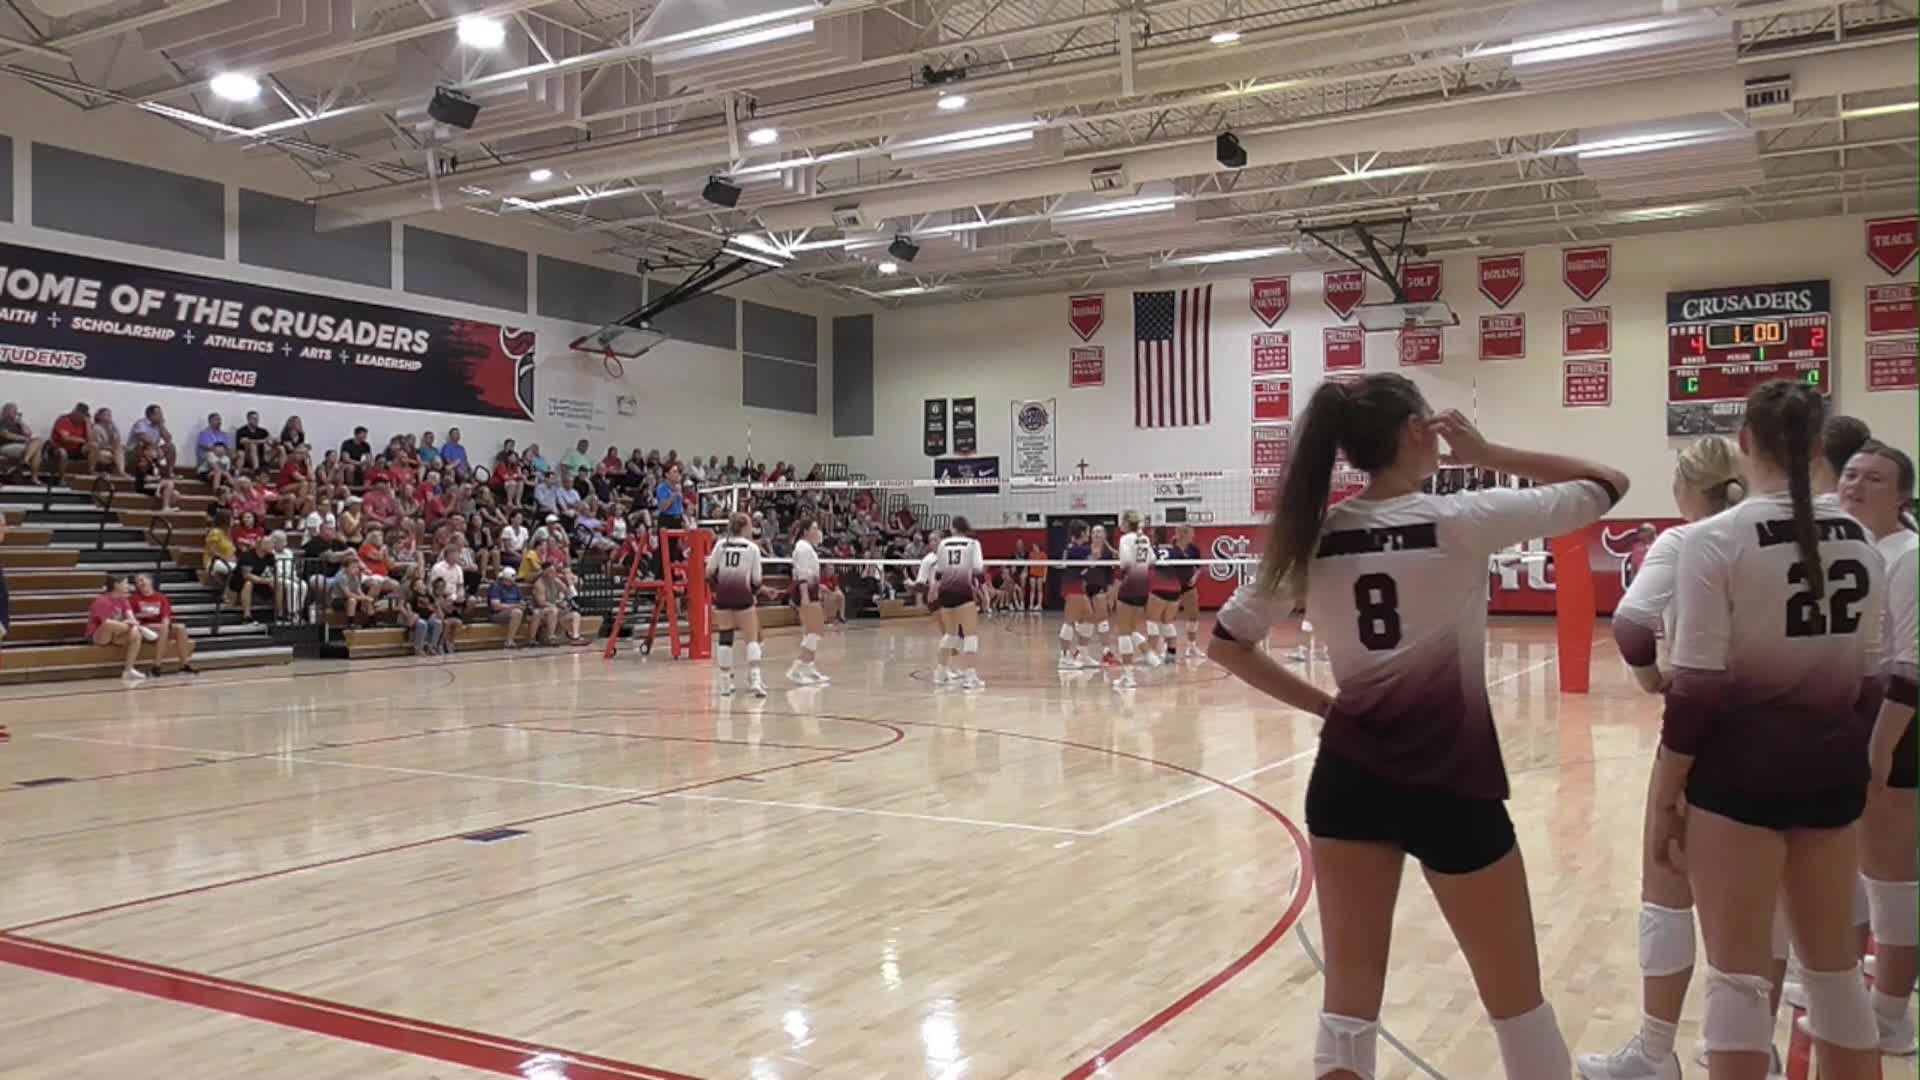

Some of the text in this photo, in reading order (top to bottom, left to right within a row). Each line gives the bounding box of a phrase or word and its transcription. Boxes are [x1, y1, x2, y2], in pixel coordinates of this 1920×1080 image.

[1682, 289, 1812, 320] CRUSADERS
[110, 284, 165, 317] OF
[174, 292, 243, 329] THE
[250, 305, 430, 354] CRUSADERS
[72, 316, 176, 341] SCHOLARSHIP
[203, 334, 275, 353] ATHLETICS
[299, 347, 332, 360] ARTS
[355, 353, 423, 371] LEADERSHIP
[1690, 336, 1704, 354] 4
[1811, 328, 1825, 347] 2
[0, 343, 87, 370] TUDENTS
[208, 367, 257, 387] HOME
[725, 551, 740, 567] 10
[948, 550, 961, 565] 13
[1354, 572, 1402, 651] 8
[1785, 559, 1870, 637] 22
